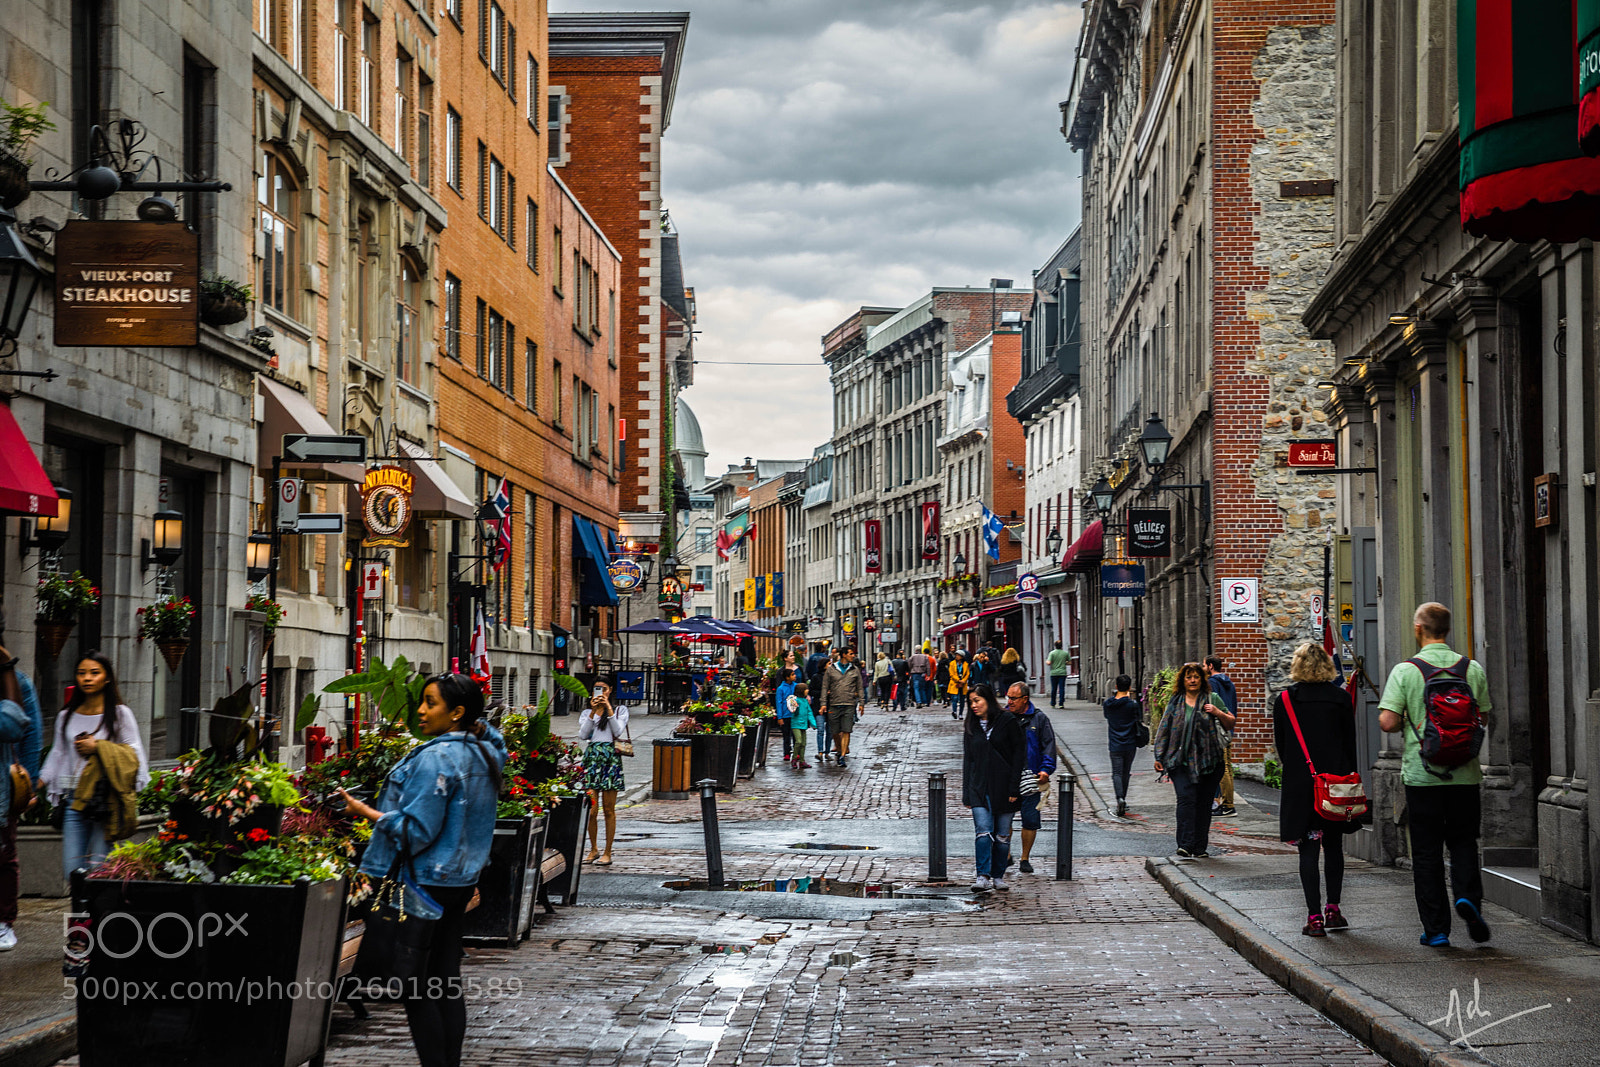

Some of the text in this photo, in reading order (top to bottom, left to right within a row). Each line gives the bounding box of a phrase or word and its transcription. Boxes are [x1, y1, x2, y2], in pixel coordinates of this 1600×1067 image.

[80, 270, 173, 283] VIEUX-PORT
[62, 287, 192, 303] STEAKHOUSE
[1133, 520, 1166, 535] DÉLICES
[1233, 586, 1246, 601] P
